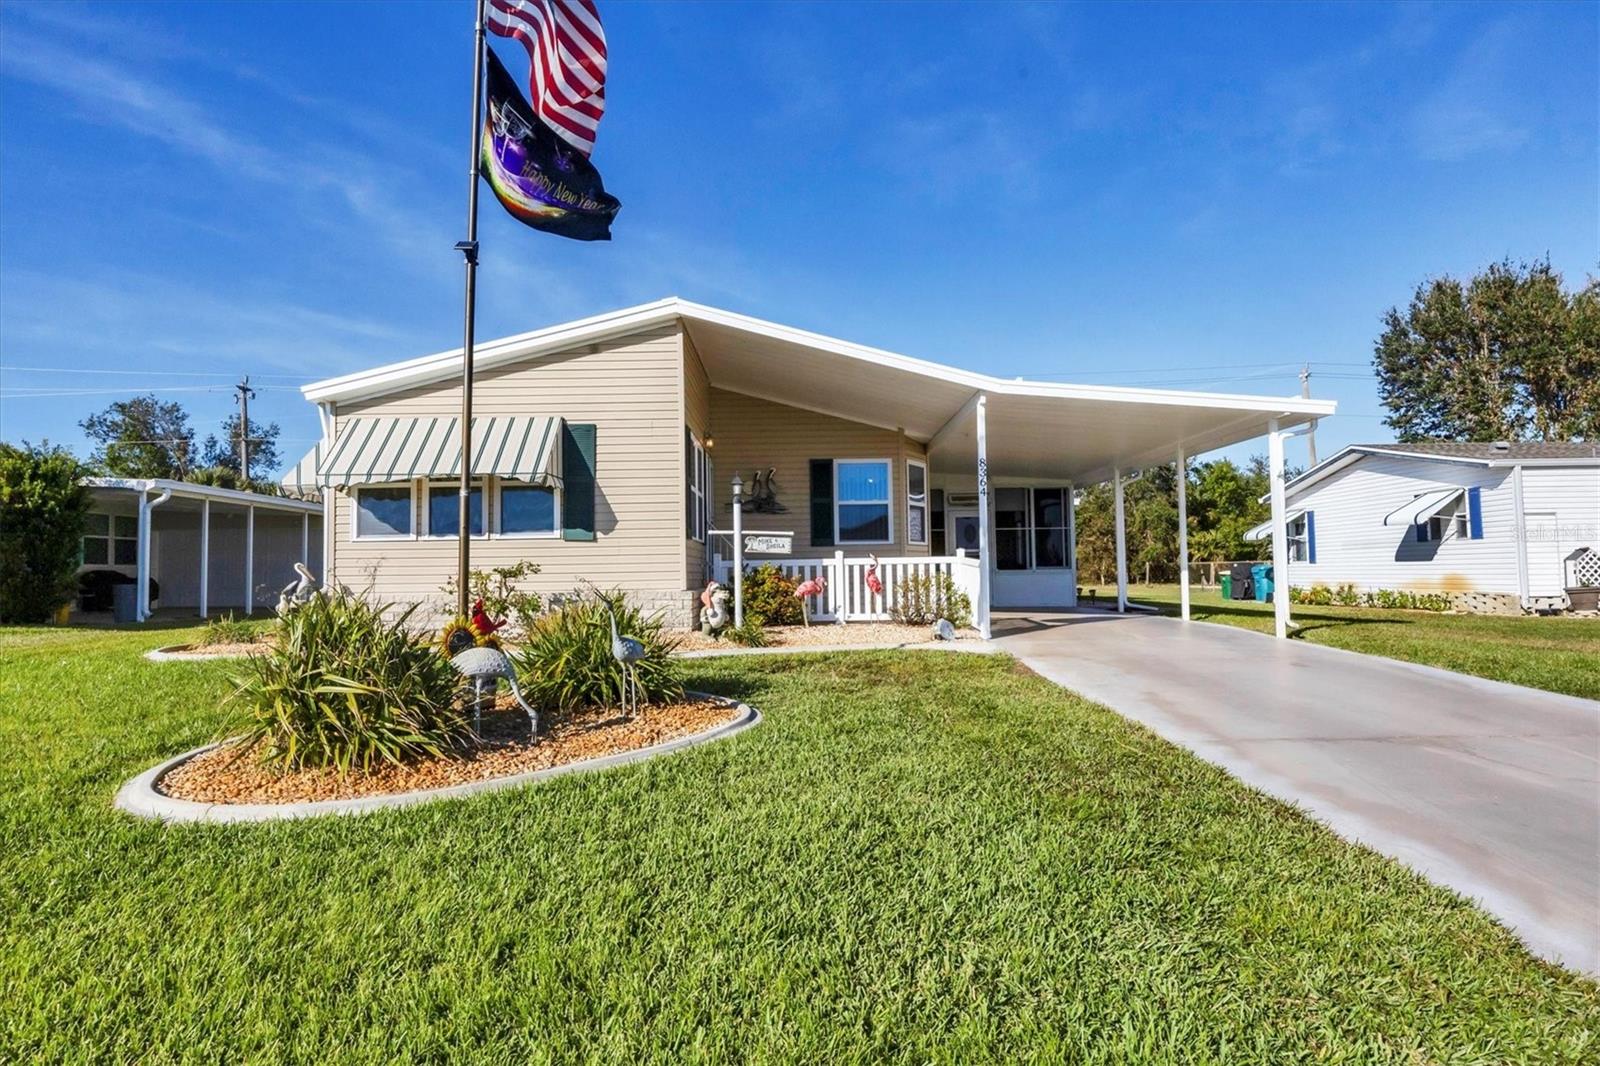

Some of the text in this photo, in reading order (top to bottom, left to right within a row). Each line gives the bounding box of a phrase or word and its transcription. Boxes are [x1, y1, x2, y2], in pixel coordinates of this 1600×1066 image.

[520, 160, 556, 194] Happy
[552, 181, 578, 205] New
[979, 457, 987, 497] 8364
